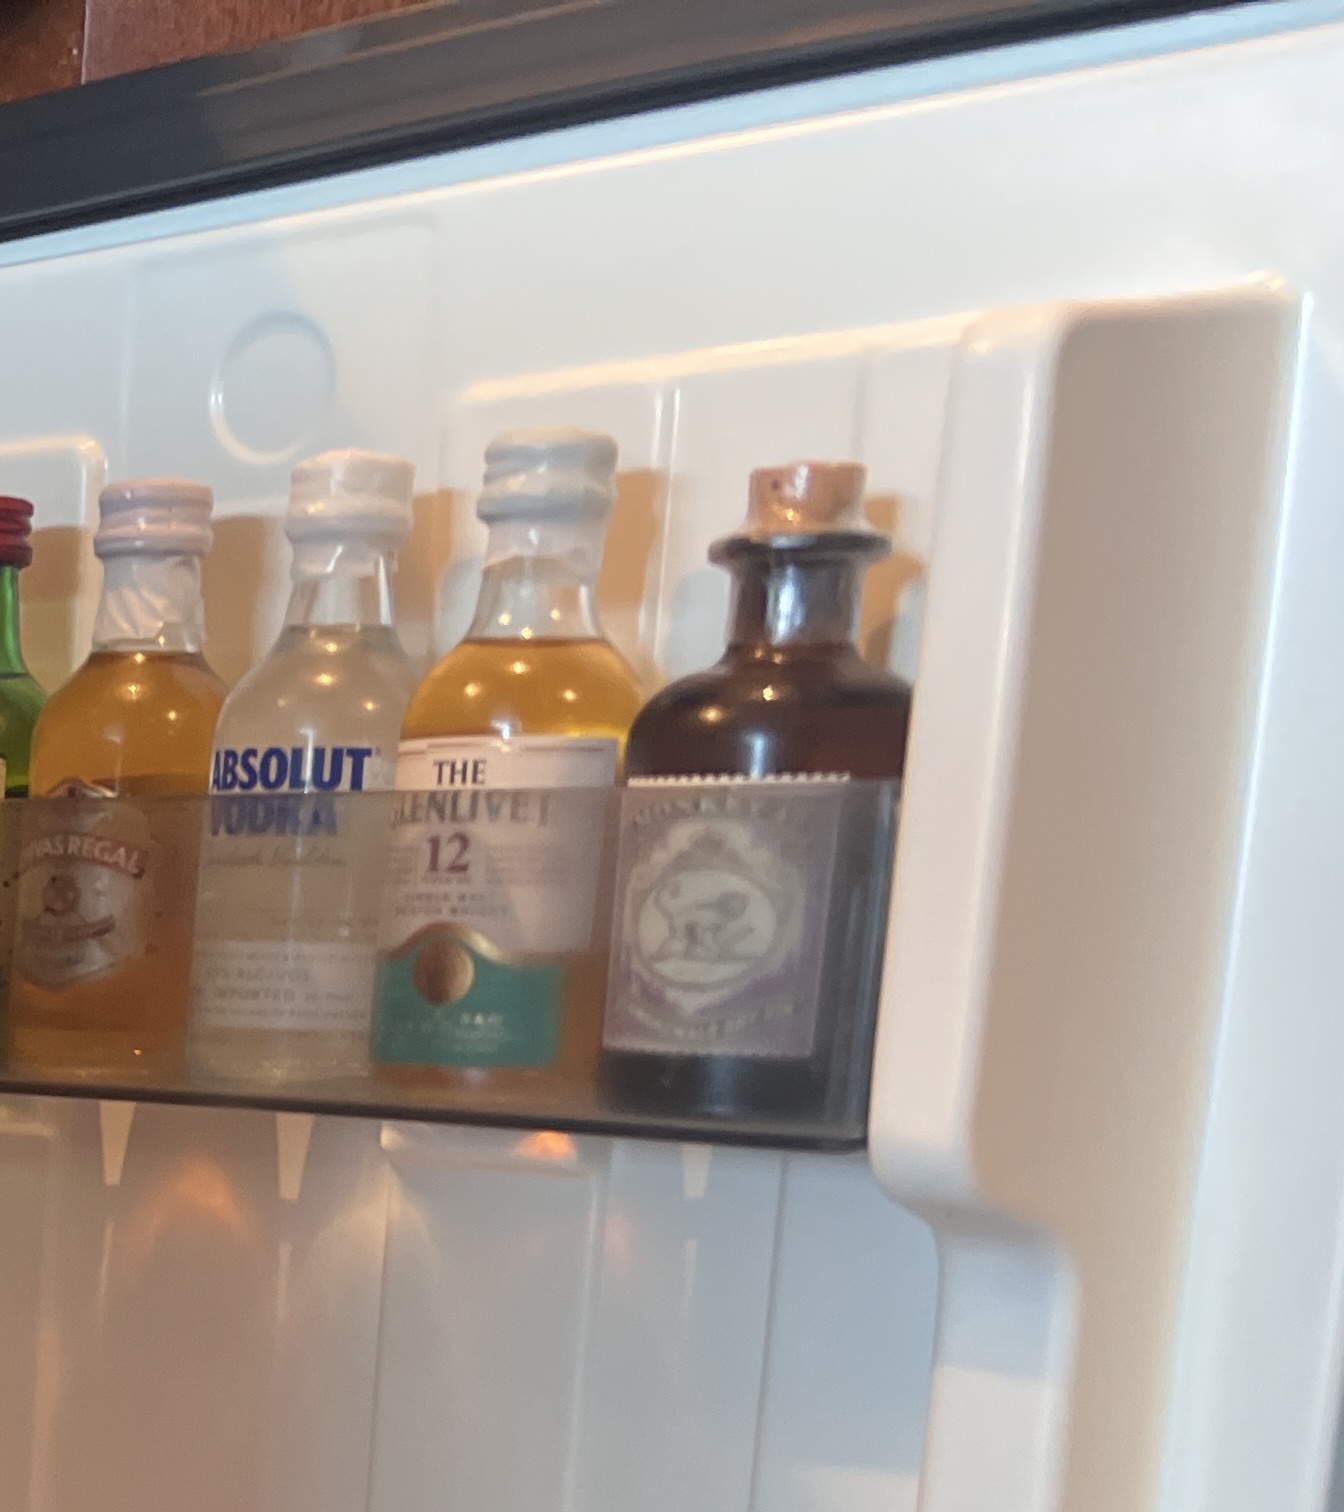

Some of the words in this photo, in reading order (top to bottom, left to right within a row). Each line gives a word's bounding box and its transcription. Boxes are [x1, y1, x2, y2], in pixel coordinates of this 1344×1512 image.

[212, 746, 373, 792] ABSOLUT
[432, 757, 488, 787] THE
[67, 833, 141, 875] REGAL
[426, 830, 472, 874] 12
